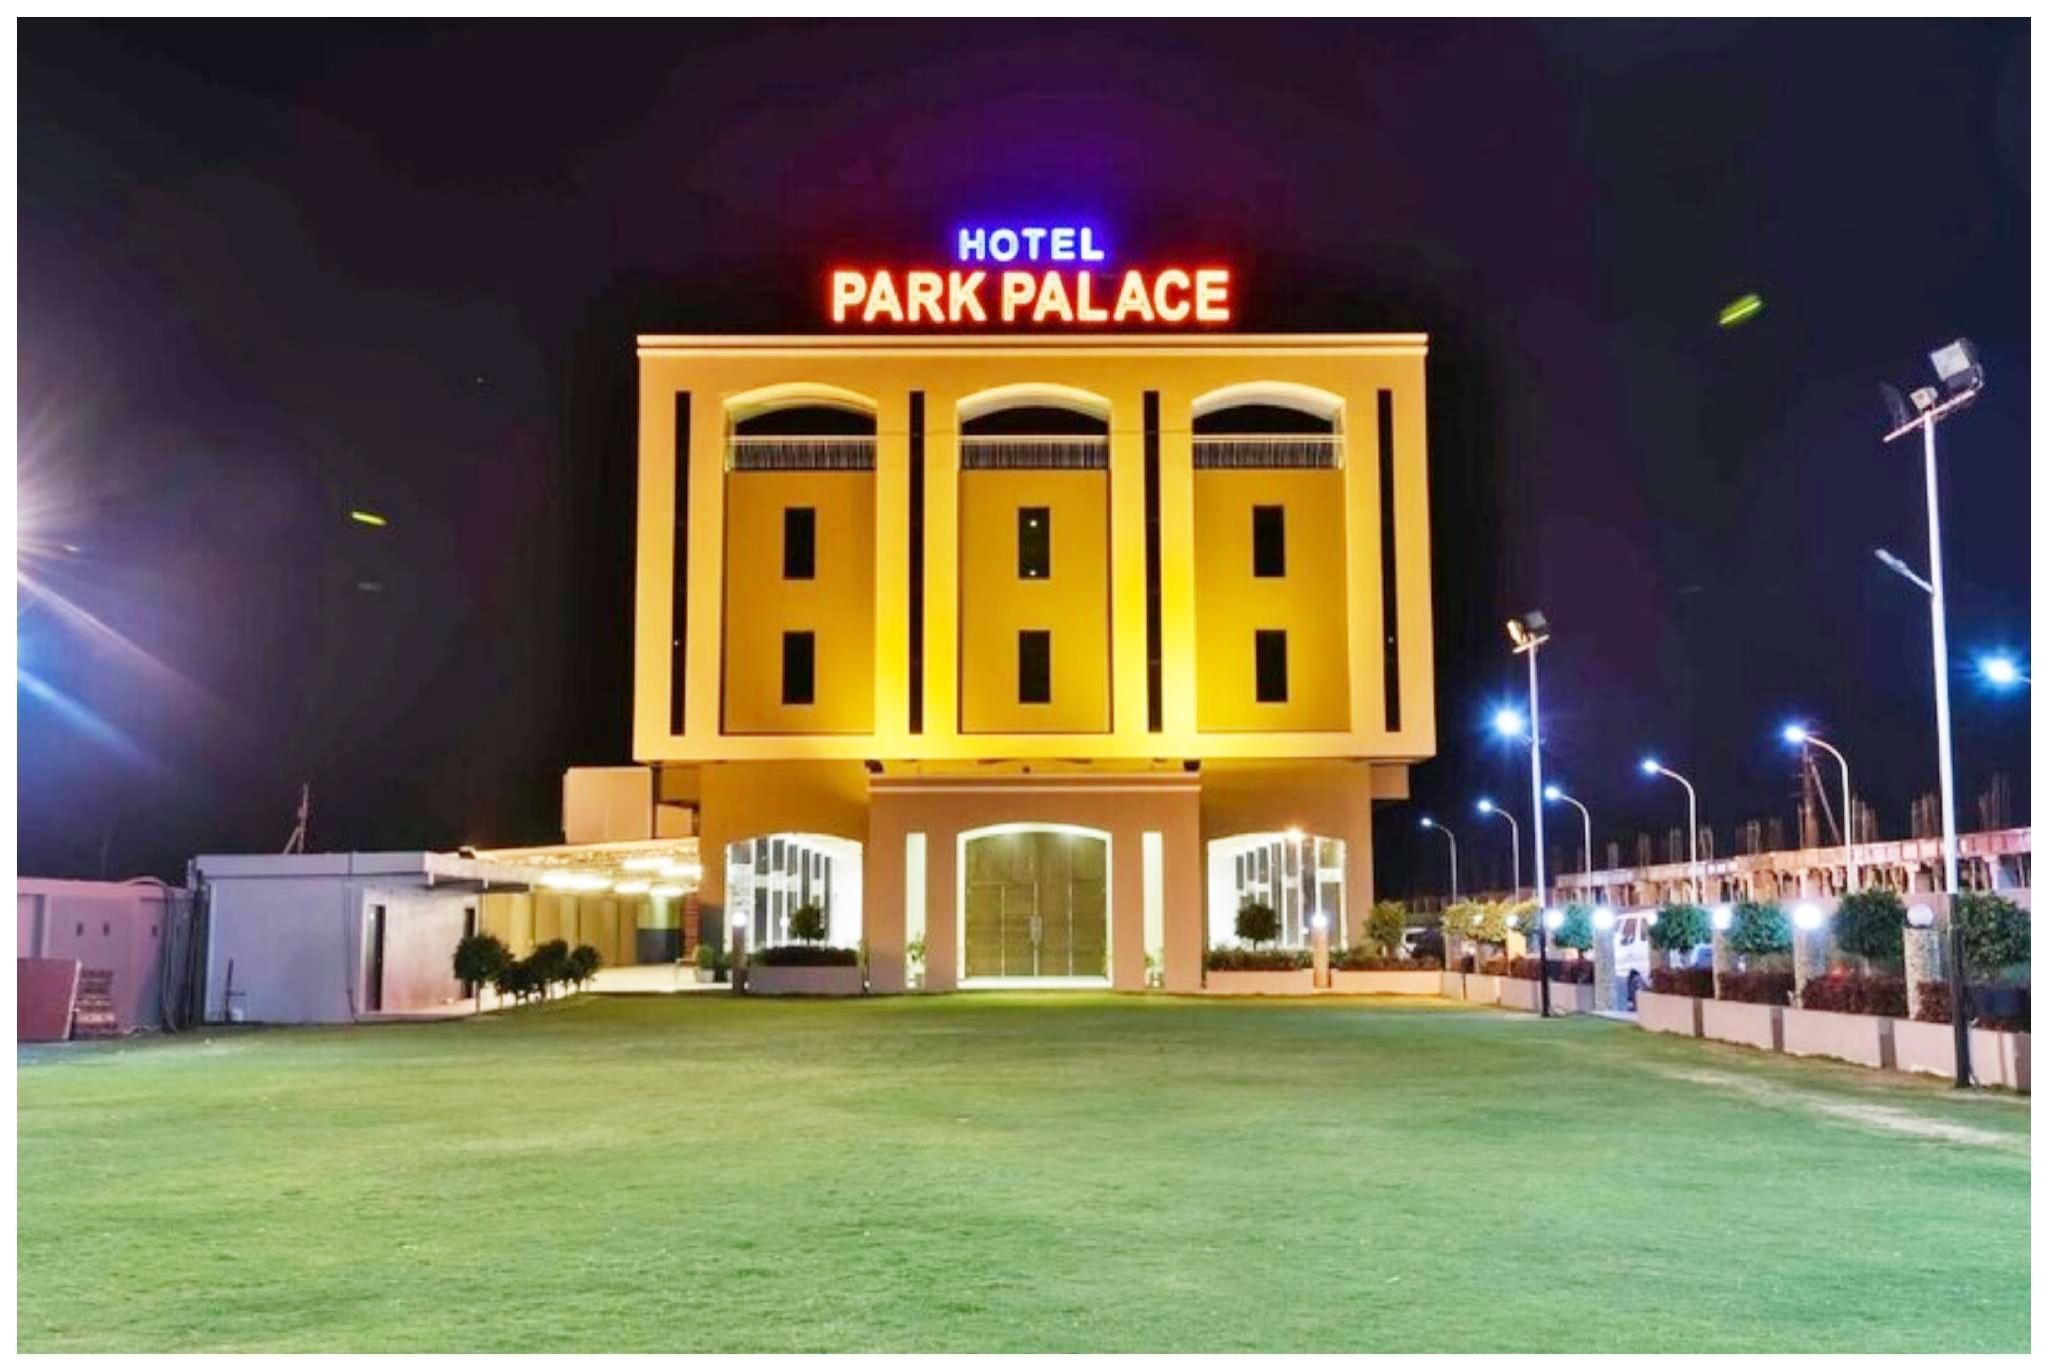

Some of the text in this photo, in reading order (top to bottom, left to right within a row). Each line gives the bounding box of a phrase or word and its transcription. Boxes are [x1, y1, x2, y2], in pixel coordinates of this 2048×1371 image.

[958, 227, 1105, 261] HOTEL
[832, 269, 1230, 323] PARK PALACE
